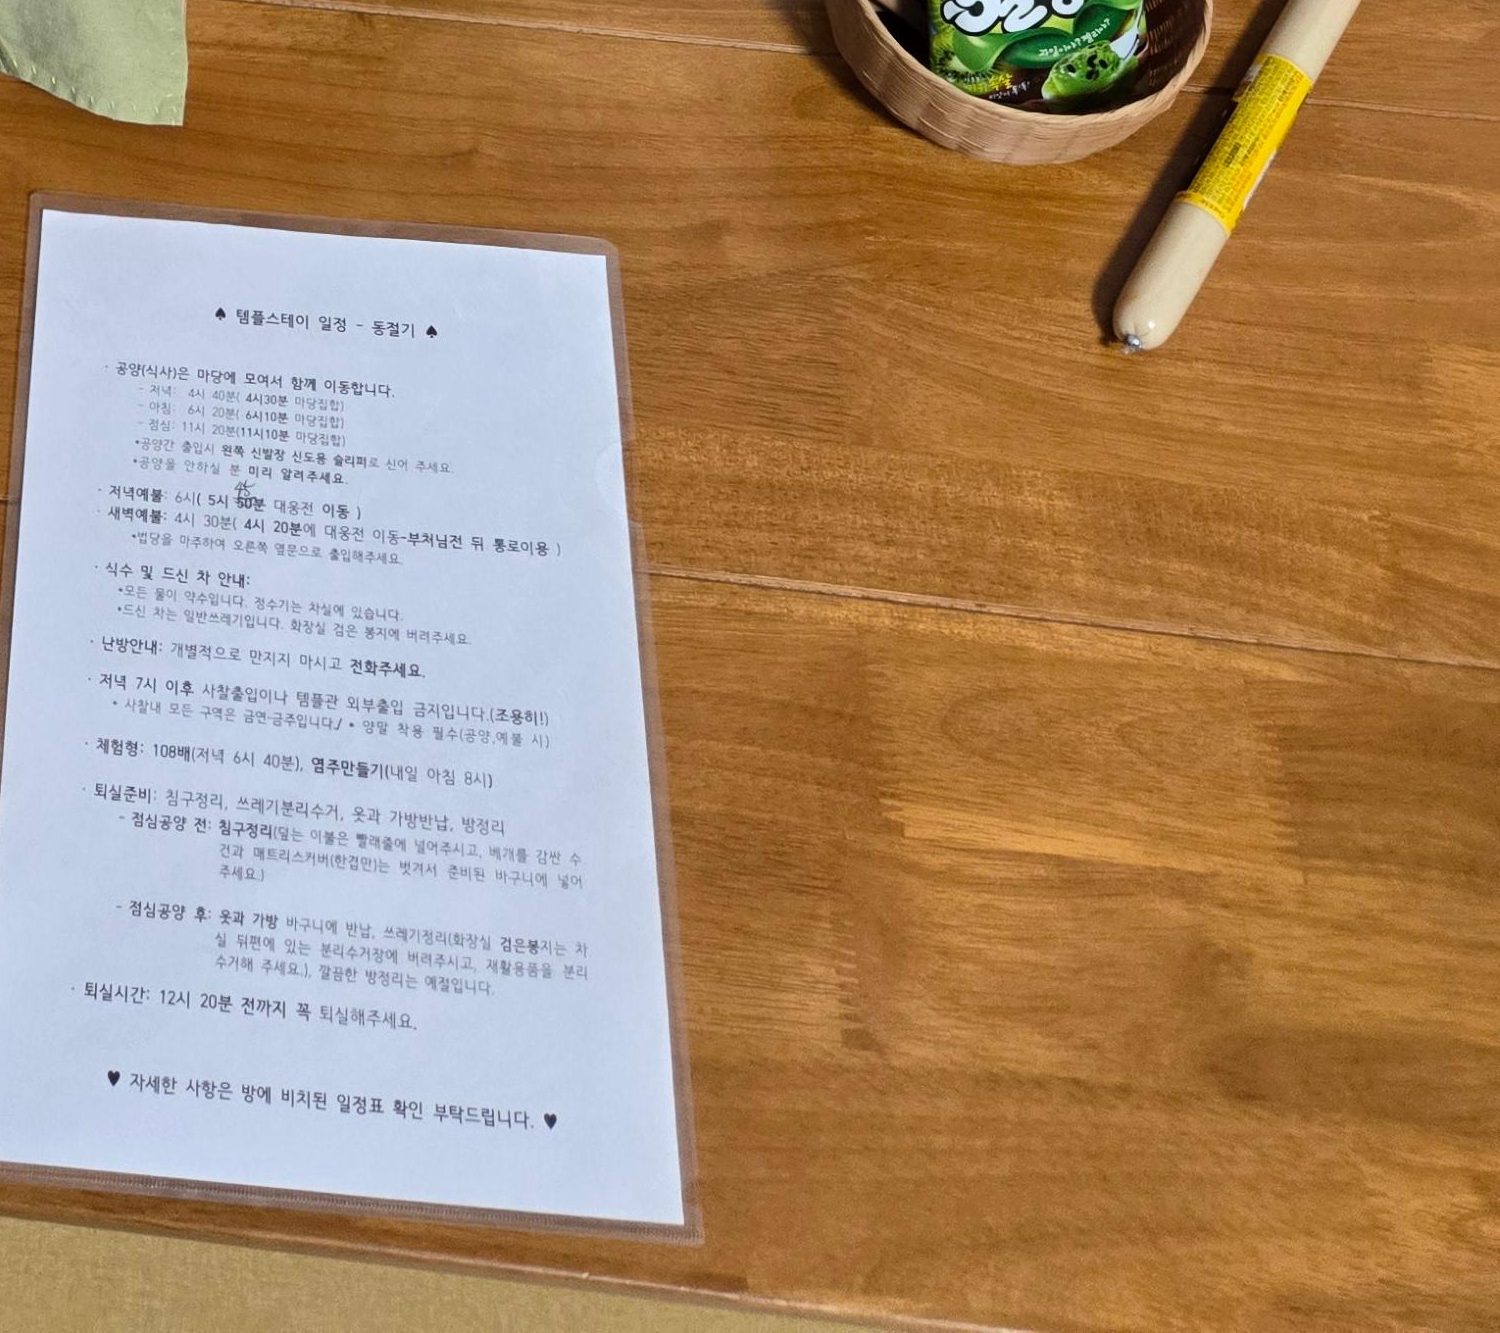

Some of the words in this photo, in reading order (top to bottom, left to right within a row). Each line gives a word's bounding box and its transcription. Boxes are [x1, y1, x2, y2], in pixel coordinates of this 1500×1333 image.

[235, 308, 309, 330] 템플스테이
[317, 315, 346, 333] 일정
[370, 319, 415, 339] 동절기
[114, 360, 190, 381] 공양(식사)은
[196, 367, 236, 385] 마당에
[242, 372, 282, 389] 모여서
[290, 375, 316, 392] 함께
[323, 378, 394, 399] 이동합니다.
[148, 400, 176, 415] 아침:
[187, 404, 205, 417] 6시
[211, 406, 239, 420] 20분(
[244, 409, 289, 425] 6시10분
[294, 412, 344, 429] 마당집합)
[107, 505, 167, 525] 새벽예불:
[173, 511, 195, 528] 4시
[203, 513, 237, 531] 30분(
[243, 517, 265, 534] 4시
[272, 519, 316, 538] 20분에
[323, 524, 364, 542] 대웅전
[371, 528, 463, 550] 이동-부처님전
[470, 535, 484, 552] 뒤
[491, 537, 550, 557] 통로이용
[98, 672, 126, 691] 저녁
[135, 675, 156, 694] 7시
[164, 679, 194, 697] 이후
[201, 682, 289, 706] 사찰출입이나
[296, 690, 339, 710] 템플관
[345, 695, 403, 716] 외부출입
[412, 701, 549, 727] 금지입니다.(조용히!)
[83, 981, 150, 1005] 퇴실시간:
[159, 988, 190, 1010] 12시
[199, 992, 233, 1013] 20분
[240, 996, 286, 1020] 전까지
[295, 1001, 311, 1022] 꼭
[318, 1004, 417, 1031] 퇴실해주세요.
[128, 1072, 178, 1095] 자세한
[185, 1077, 233, 1101] 사항은
[241, 1083, 271, 1105] 방에
[280, 1087, 327, 1111] 비치된
[336, 1093, 385, 1115] 일정표
[392, 1098, 423, 1121] 확인
[432, 1102, 534, 1130] 부탁드립니다.
